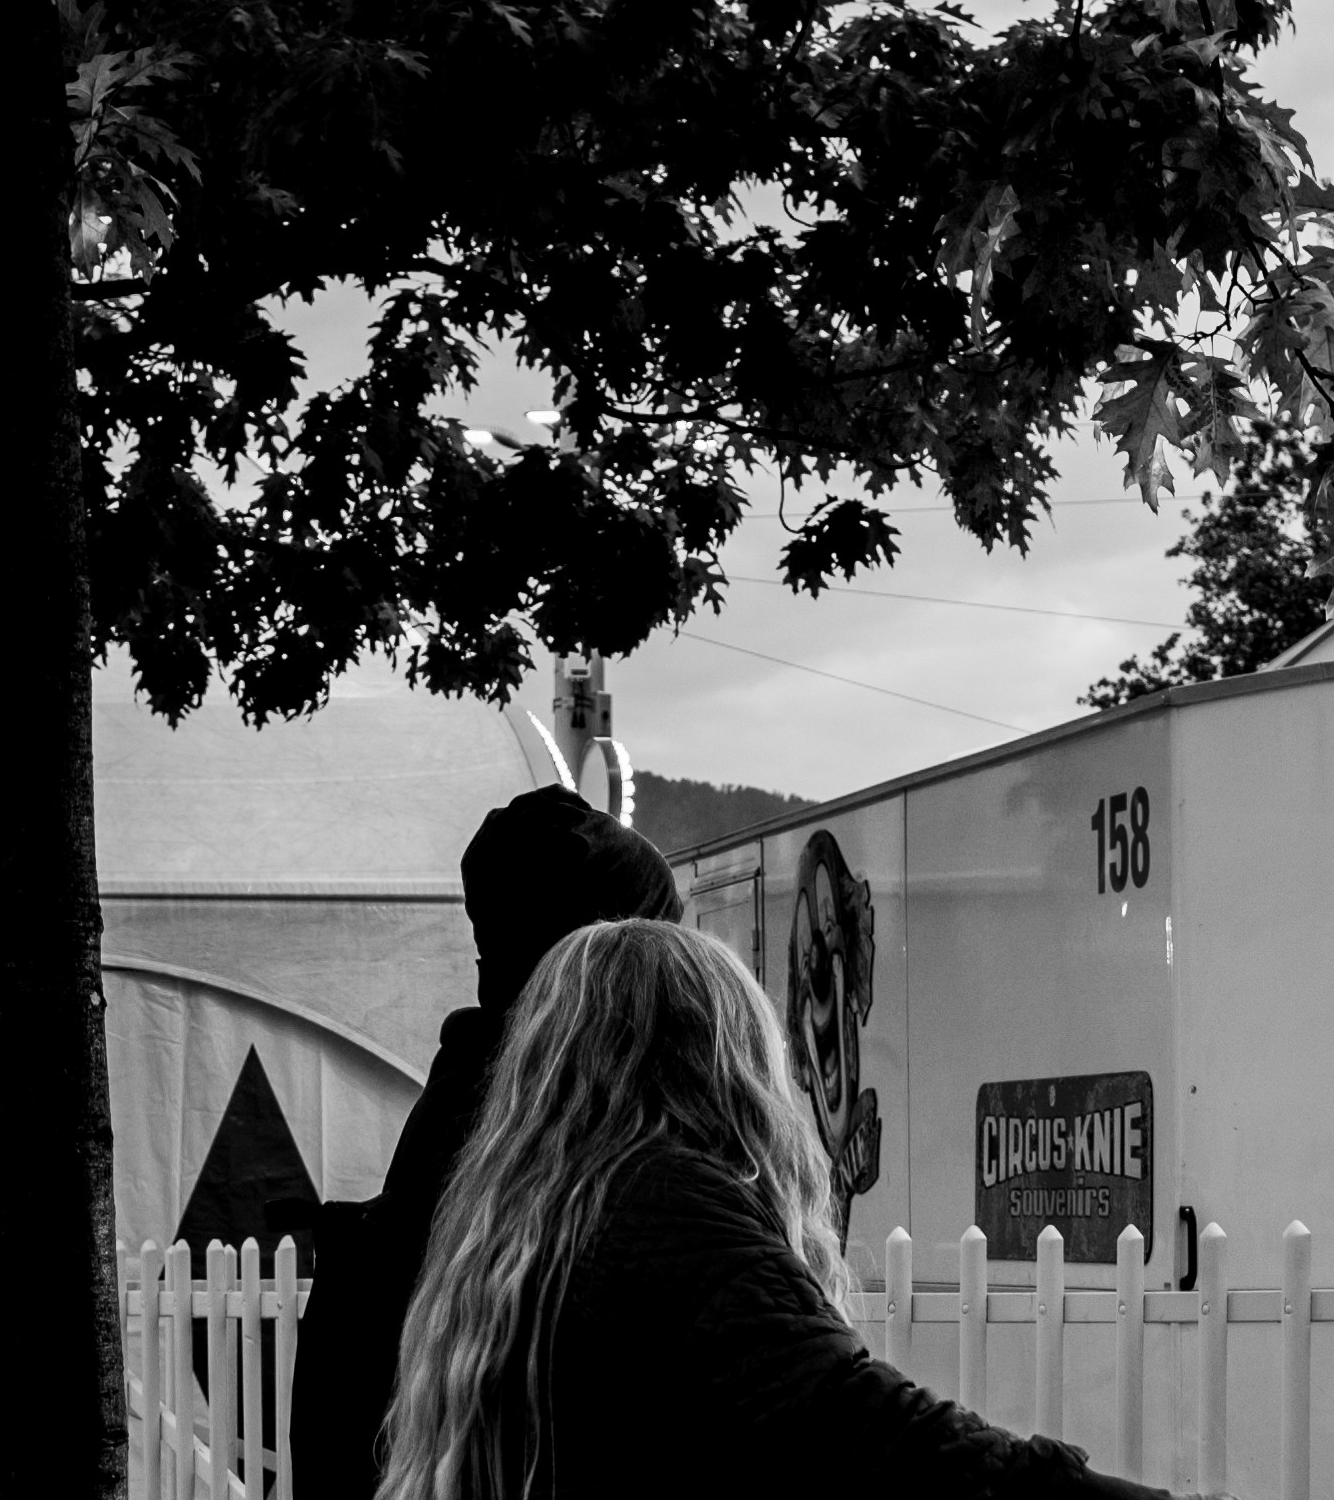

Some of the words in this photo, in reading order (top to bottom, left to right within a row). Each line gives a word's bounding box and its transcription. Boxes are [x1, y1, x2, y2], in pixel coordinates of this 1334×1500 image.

[1091, 786, 1150, 895] 158
[983, 1116, 1066, 1188] CIRCUS
[1074, 1101, 1142, 1180] KNIE
[1010, 1177, 1109, 1217] souvenirs
